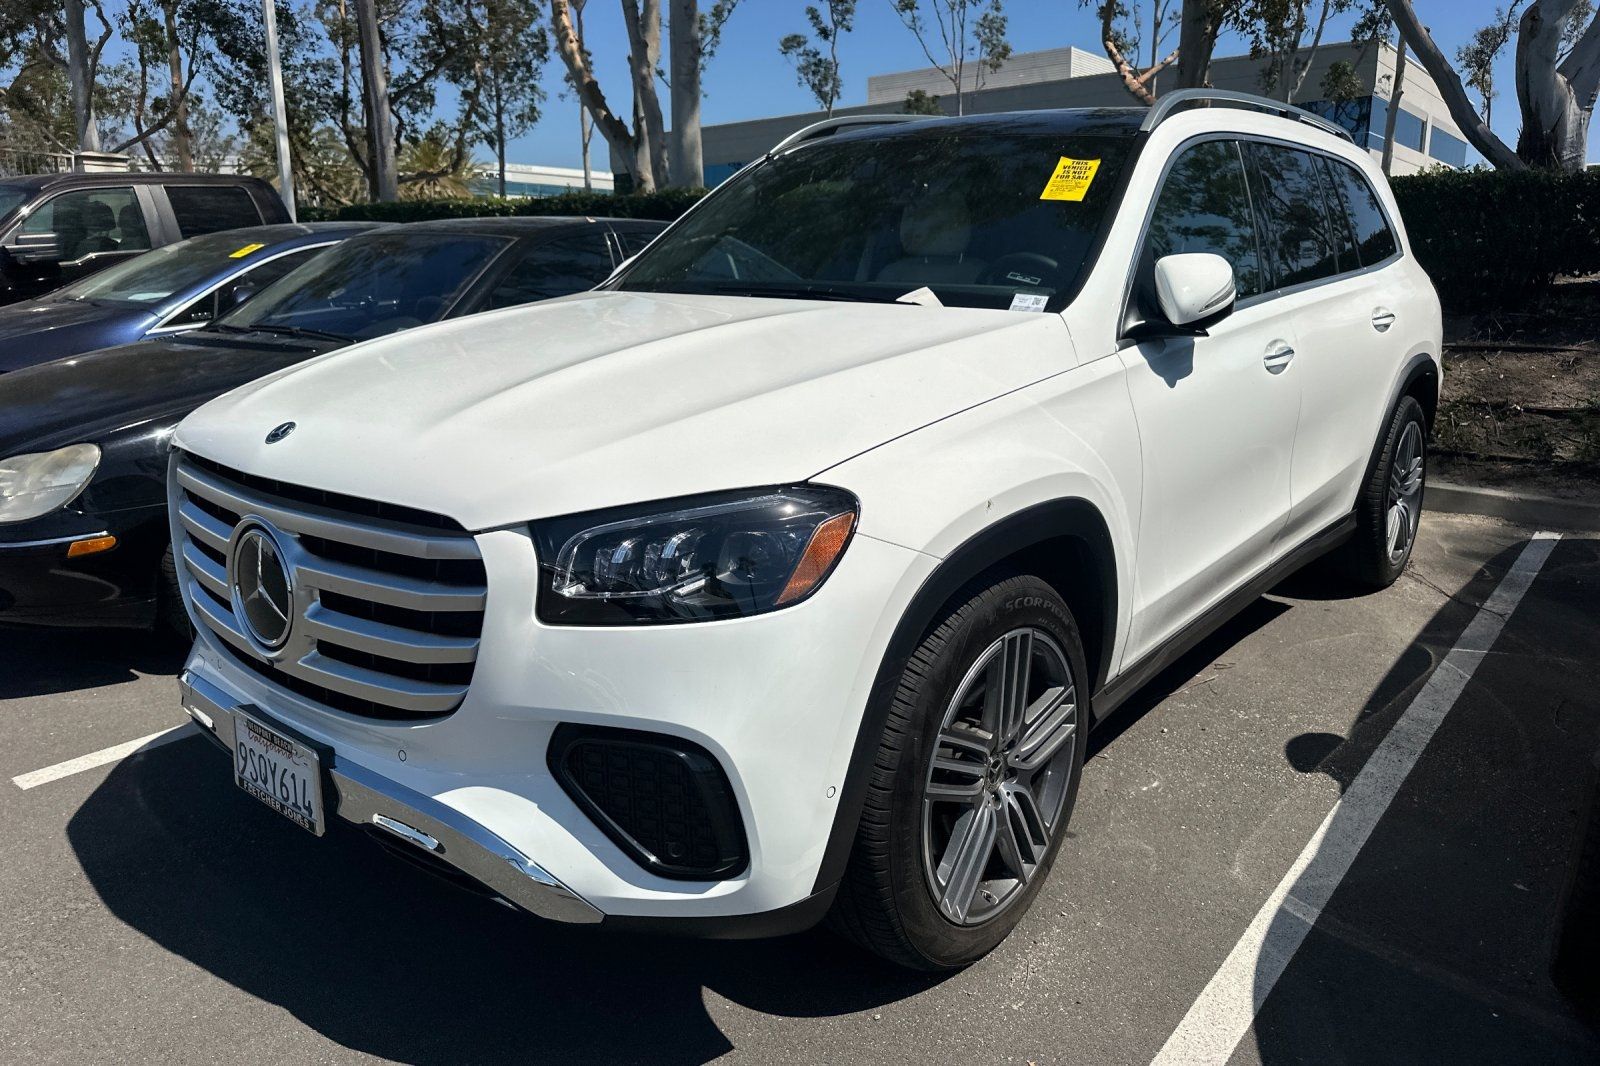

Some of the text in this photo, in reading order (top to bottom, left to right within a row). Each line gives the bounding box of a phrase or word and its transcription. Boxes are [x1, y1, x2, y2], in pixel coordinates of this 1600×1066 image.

[1005, 597, 1071, 624] SCORPION
[247, 720, 293, 754] NEWPORT BEACH
[239, 742, 313, 818] 9SQY614
[244, 782, 309, 828] FLETCHER JONES
